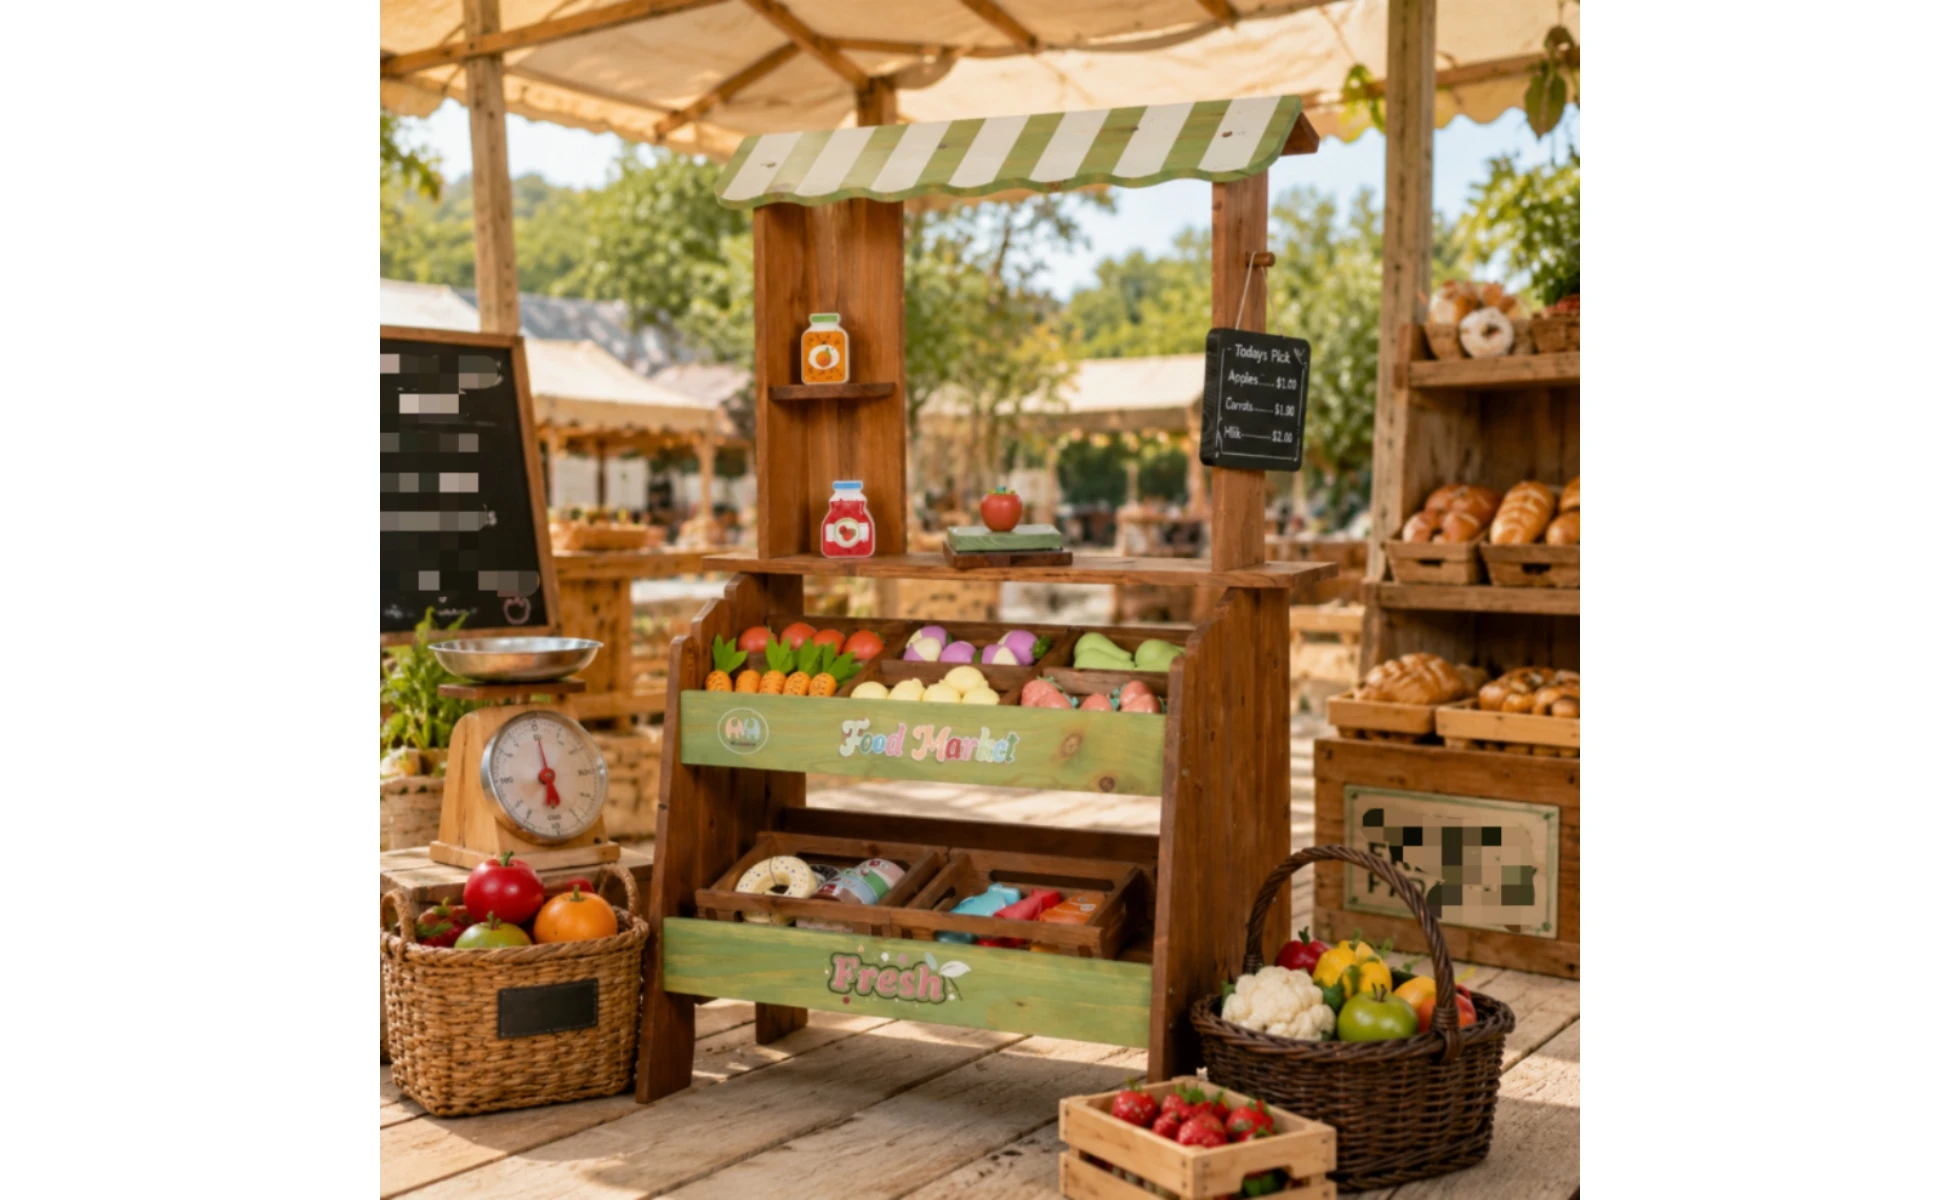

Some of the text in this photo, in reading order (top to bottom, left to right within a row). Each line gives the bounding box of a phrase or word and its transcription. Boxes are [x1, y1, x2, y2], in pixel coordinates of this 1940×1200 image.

[1235, 343, 1291, 364] Todays Pick
[839, 718, 1020, 763] Food Market
[829, 953, 946, 1003] Fresh
